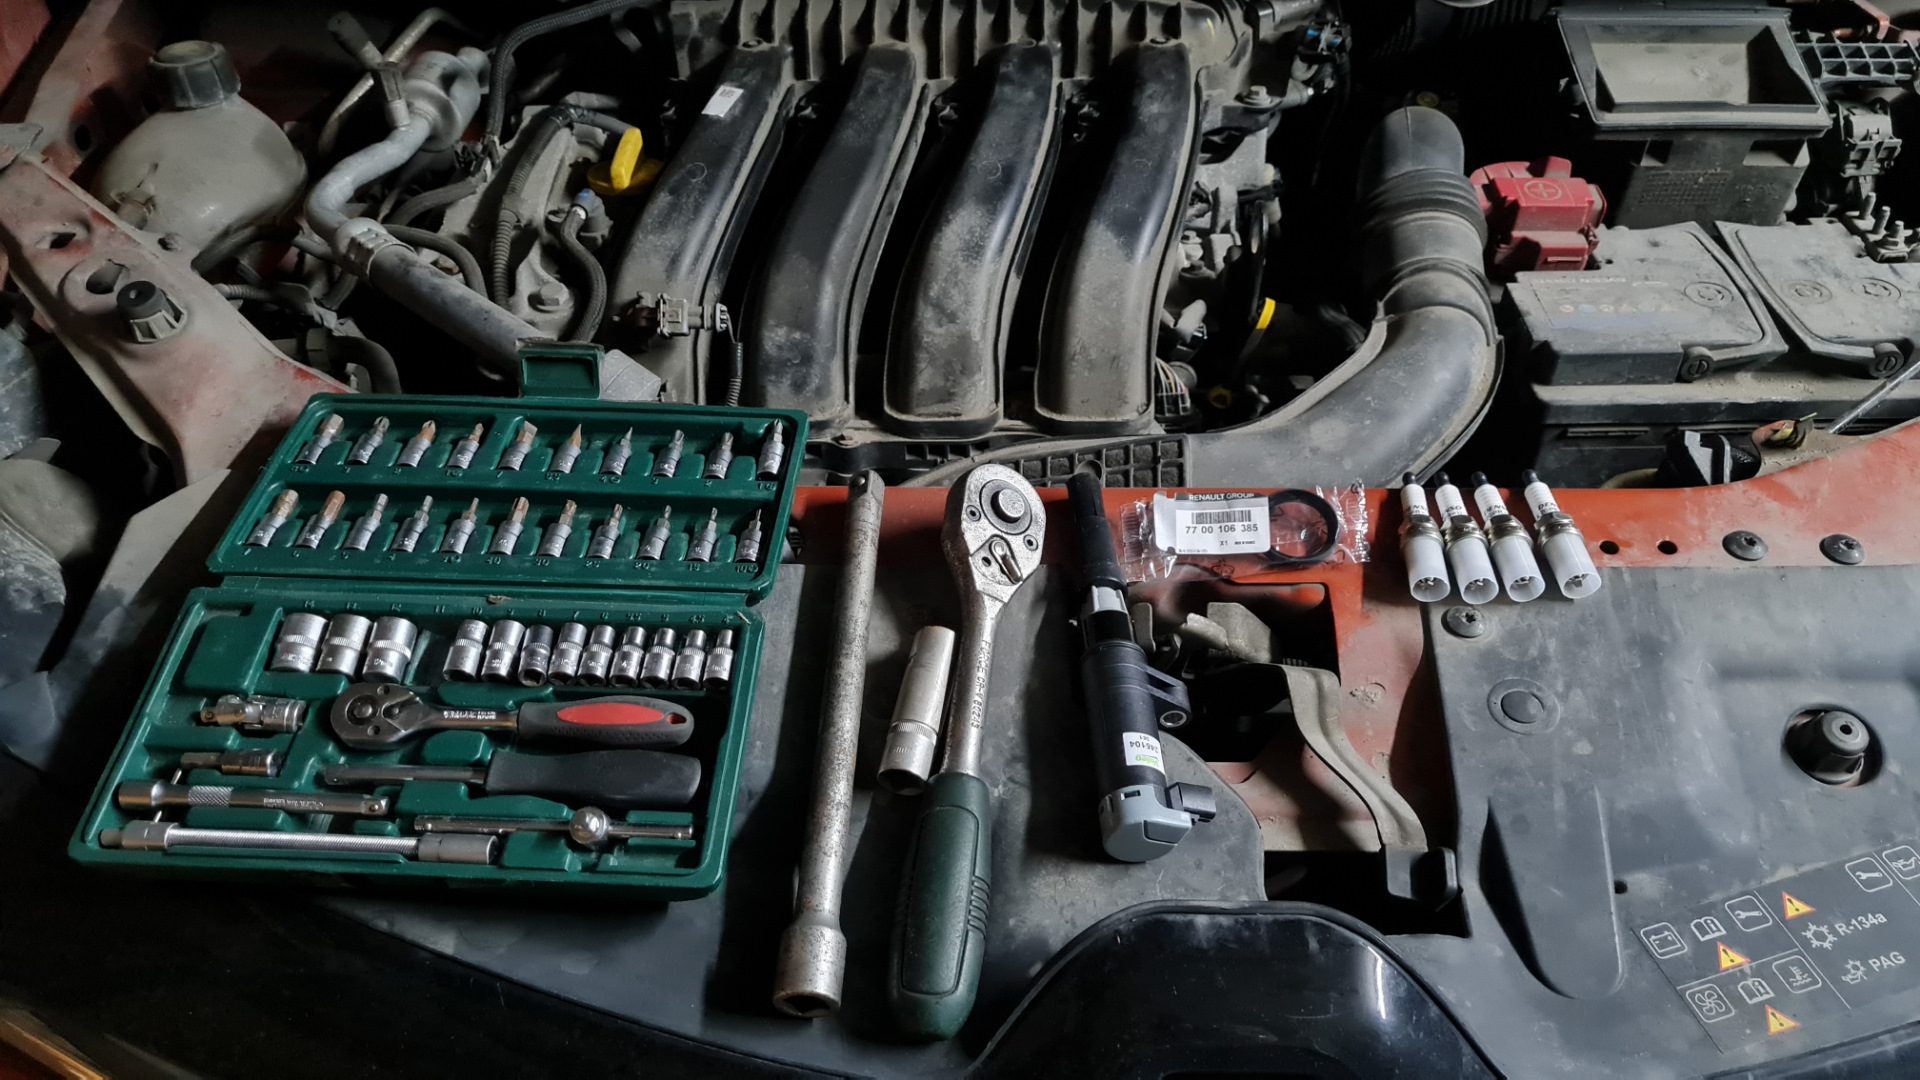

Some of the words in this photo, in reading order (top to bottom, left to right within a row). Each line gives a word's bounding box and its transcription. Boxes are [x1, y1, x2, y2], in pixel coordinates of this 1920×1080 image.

[1185, 526, 1198, 534] 77
[1201, 525, 1214, 534] 00
[1218, 524, 1236, 533] 106
[1240, 524, 1259, 532] 385
[435, 604, 446, 614] 11
[977, 639, 992, 676] FORCE
[1834, 912, 1888, 936] R-134a
[1868, 951, 1906, 972] PAG
